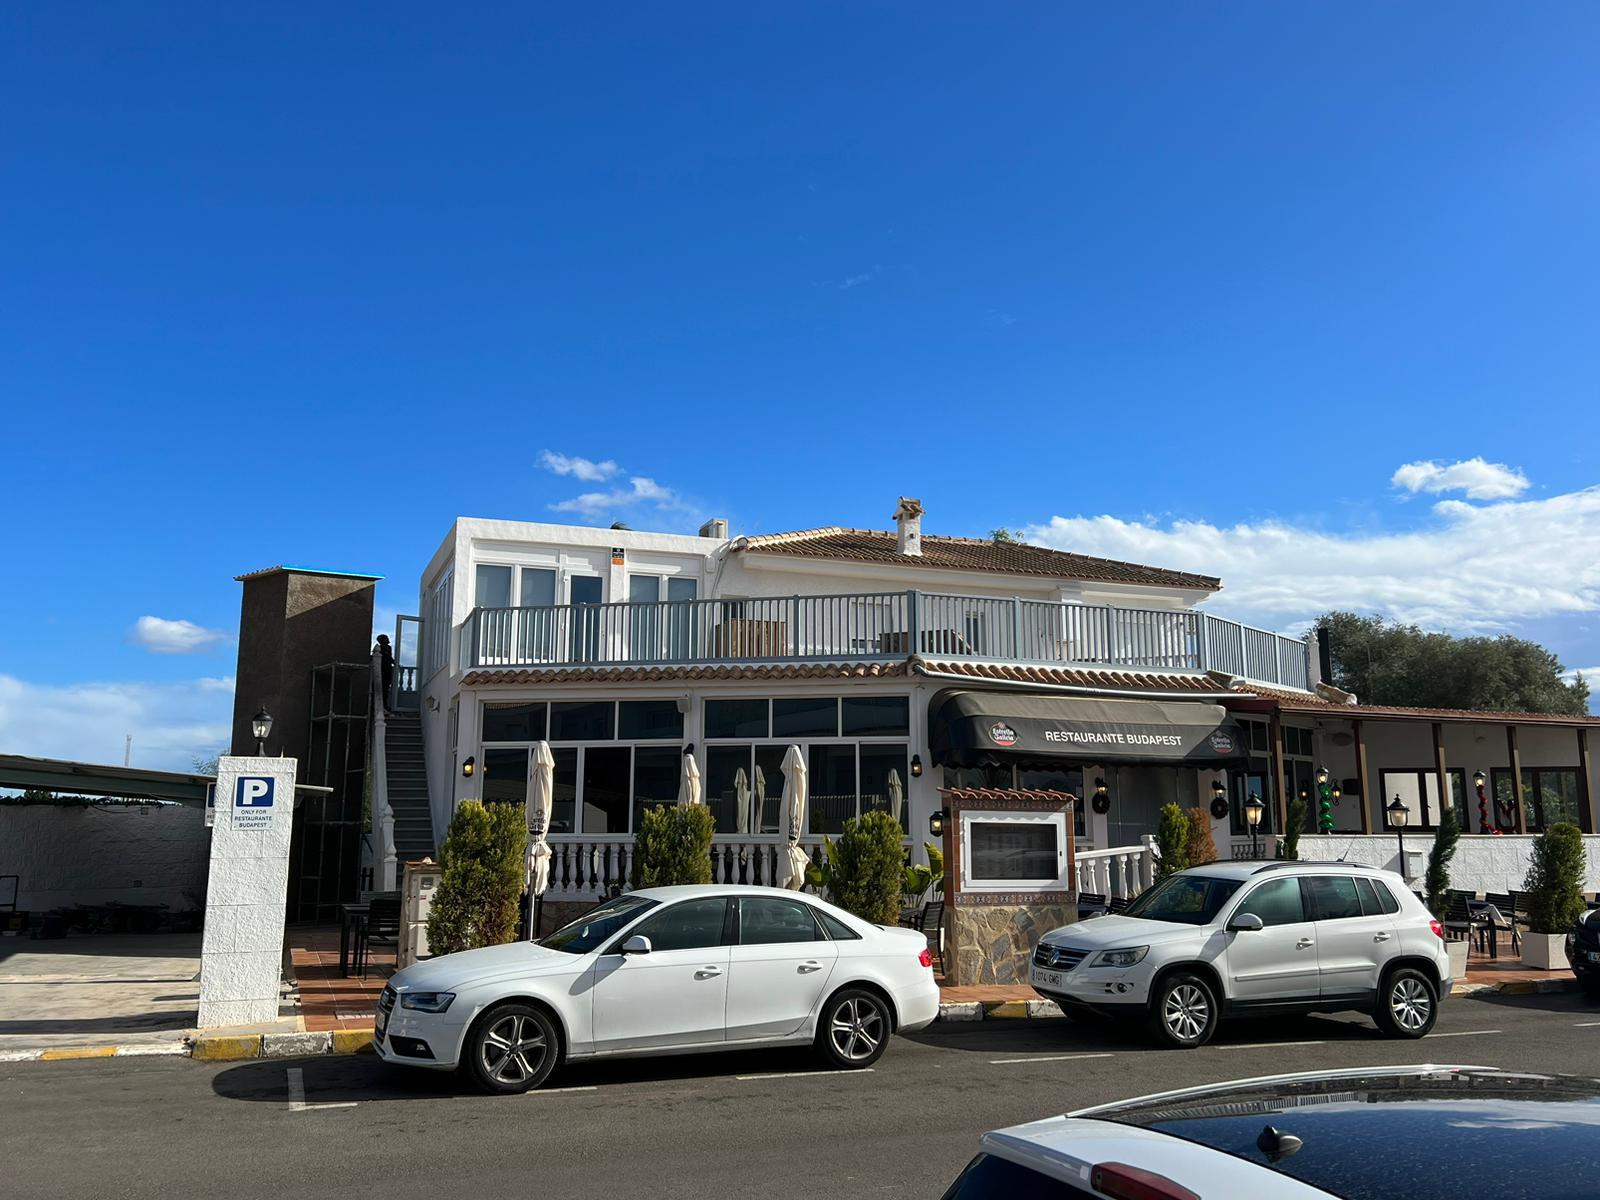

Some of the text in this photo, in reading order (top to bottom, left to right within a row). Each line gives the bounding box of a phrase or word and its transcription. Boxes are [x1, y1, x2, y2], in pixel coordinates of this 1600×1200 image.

[1045, 731, 1182, 746] RESTAURANTE BUDAPEST
[242, 779, 268, 805] P
